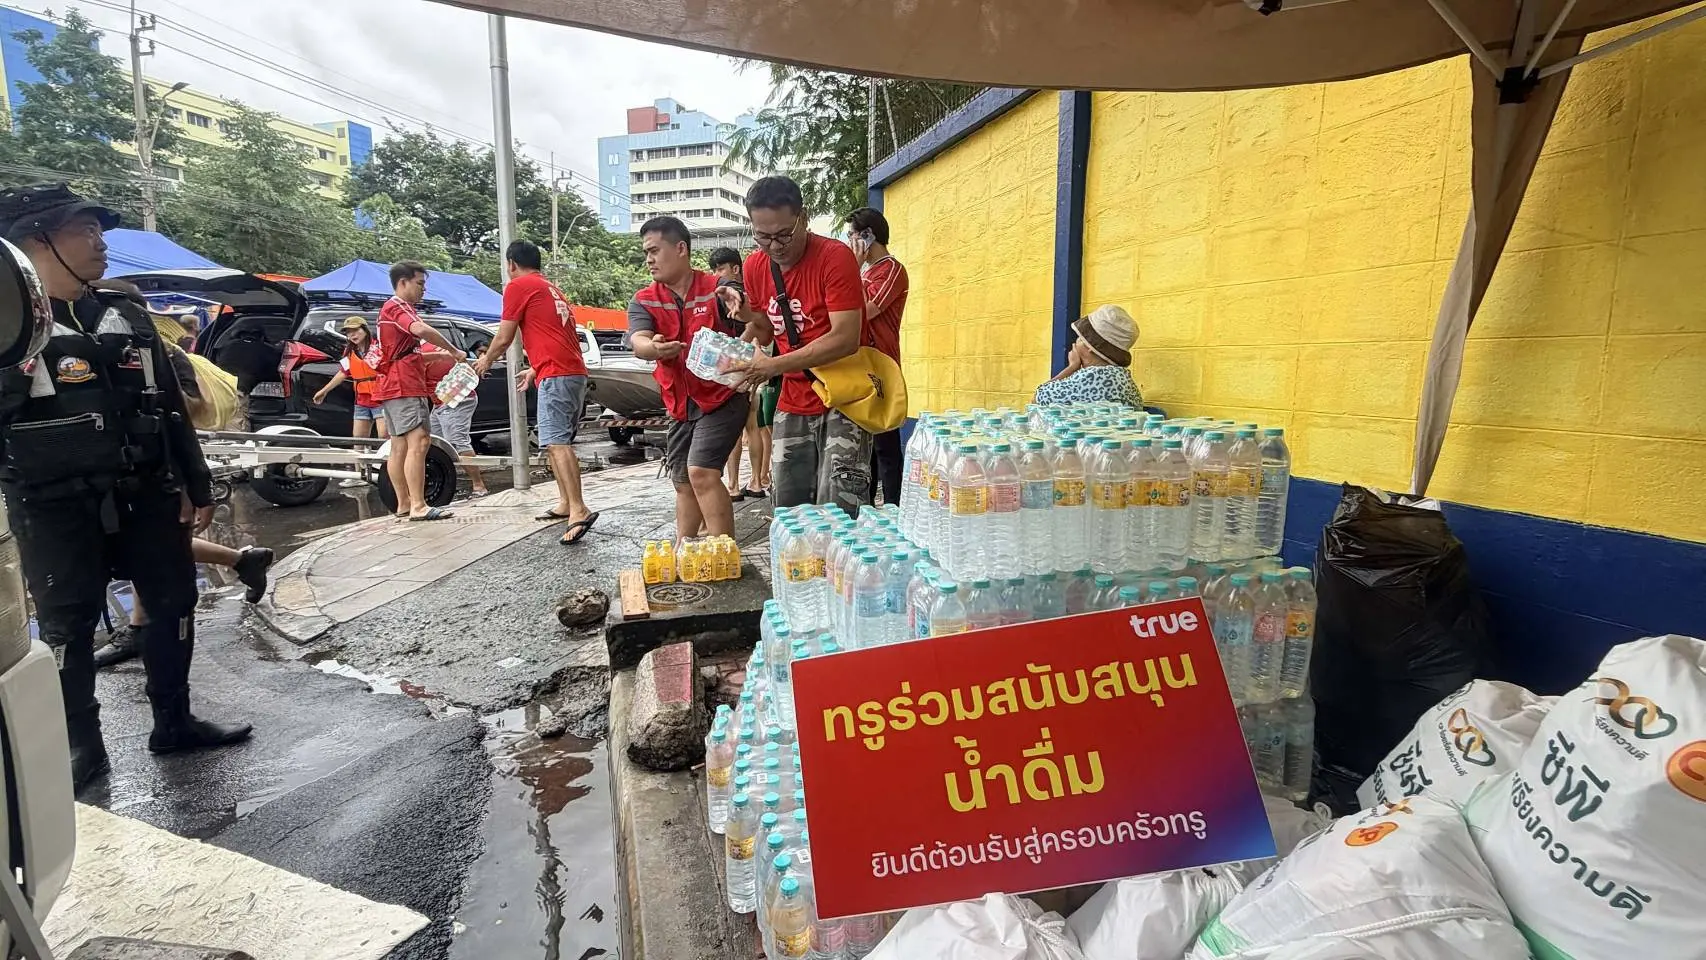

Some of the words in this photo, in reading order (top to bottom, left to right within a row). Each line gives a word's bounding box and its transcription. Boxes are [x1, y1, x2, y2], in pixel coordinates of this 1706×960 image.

[1129, 610, 1198, 639] true
[823, 652, 1198, 751] ทรูร่วมสนับสนุน
[944, 727, 1106, 814] น้ำดื่ม
[1541, 730, 1610, 822] ซีพี
[870, 807, 1207, 879] ยินดีต้อนรับสู่ครอบครัวทรู
